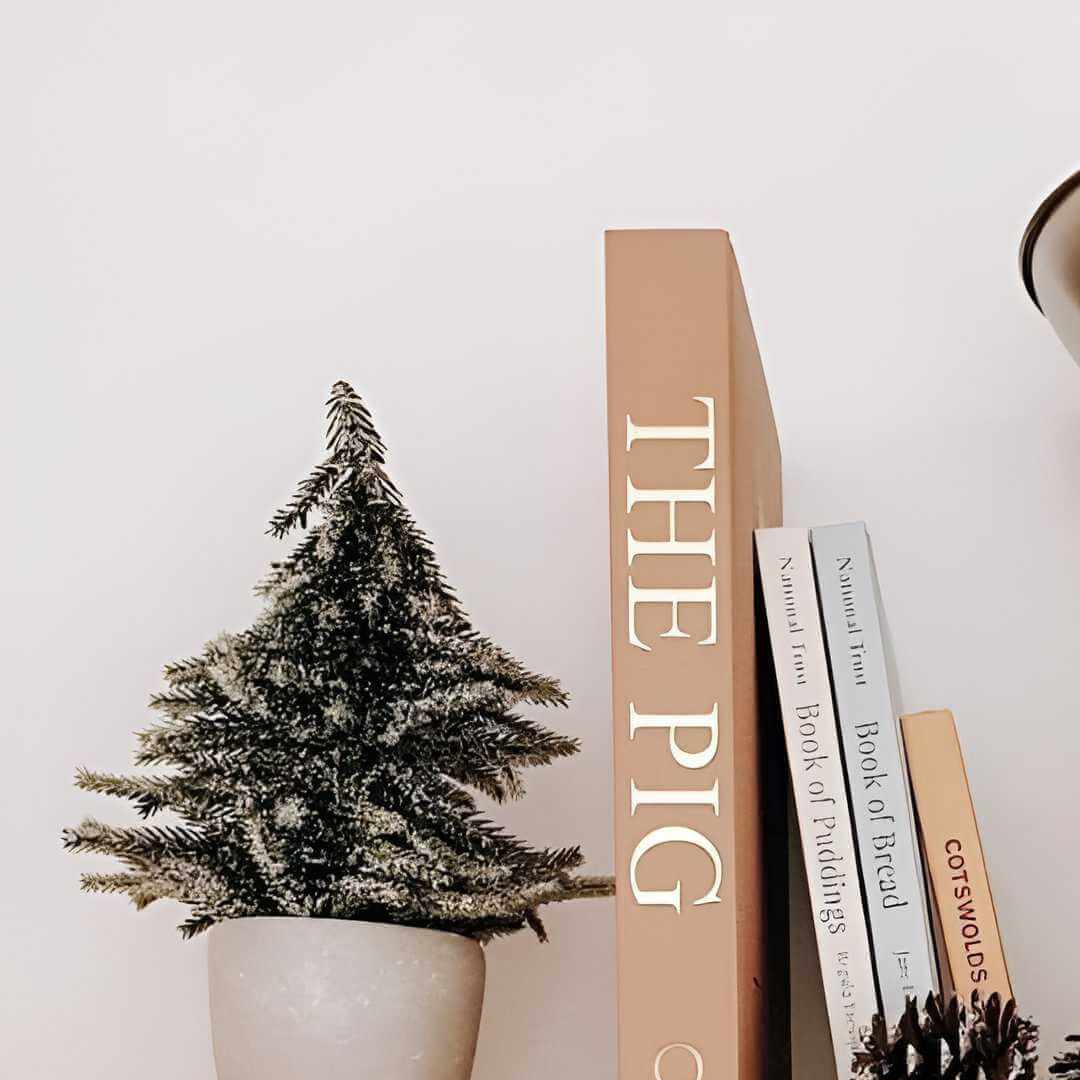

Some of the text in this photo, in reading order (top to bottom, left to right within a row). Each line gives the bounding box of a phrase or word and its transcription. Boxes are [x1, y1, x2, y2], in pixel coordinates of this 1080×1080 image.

[626, 396, 722, 915] THE PIG
[795, 703, 829, 772] Book
[854, 721, 888, 790] Book
[807, 781, 836, 805] of
[867, 799, 896, 823] of
[812, 815, 847, 936] Puddings
[871, 832, 909, 910] Bread
[944, 838, 988, 983] COTSWOLDS
